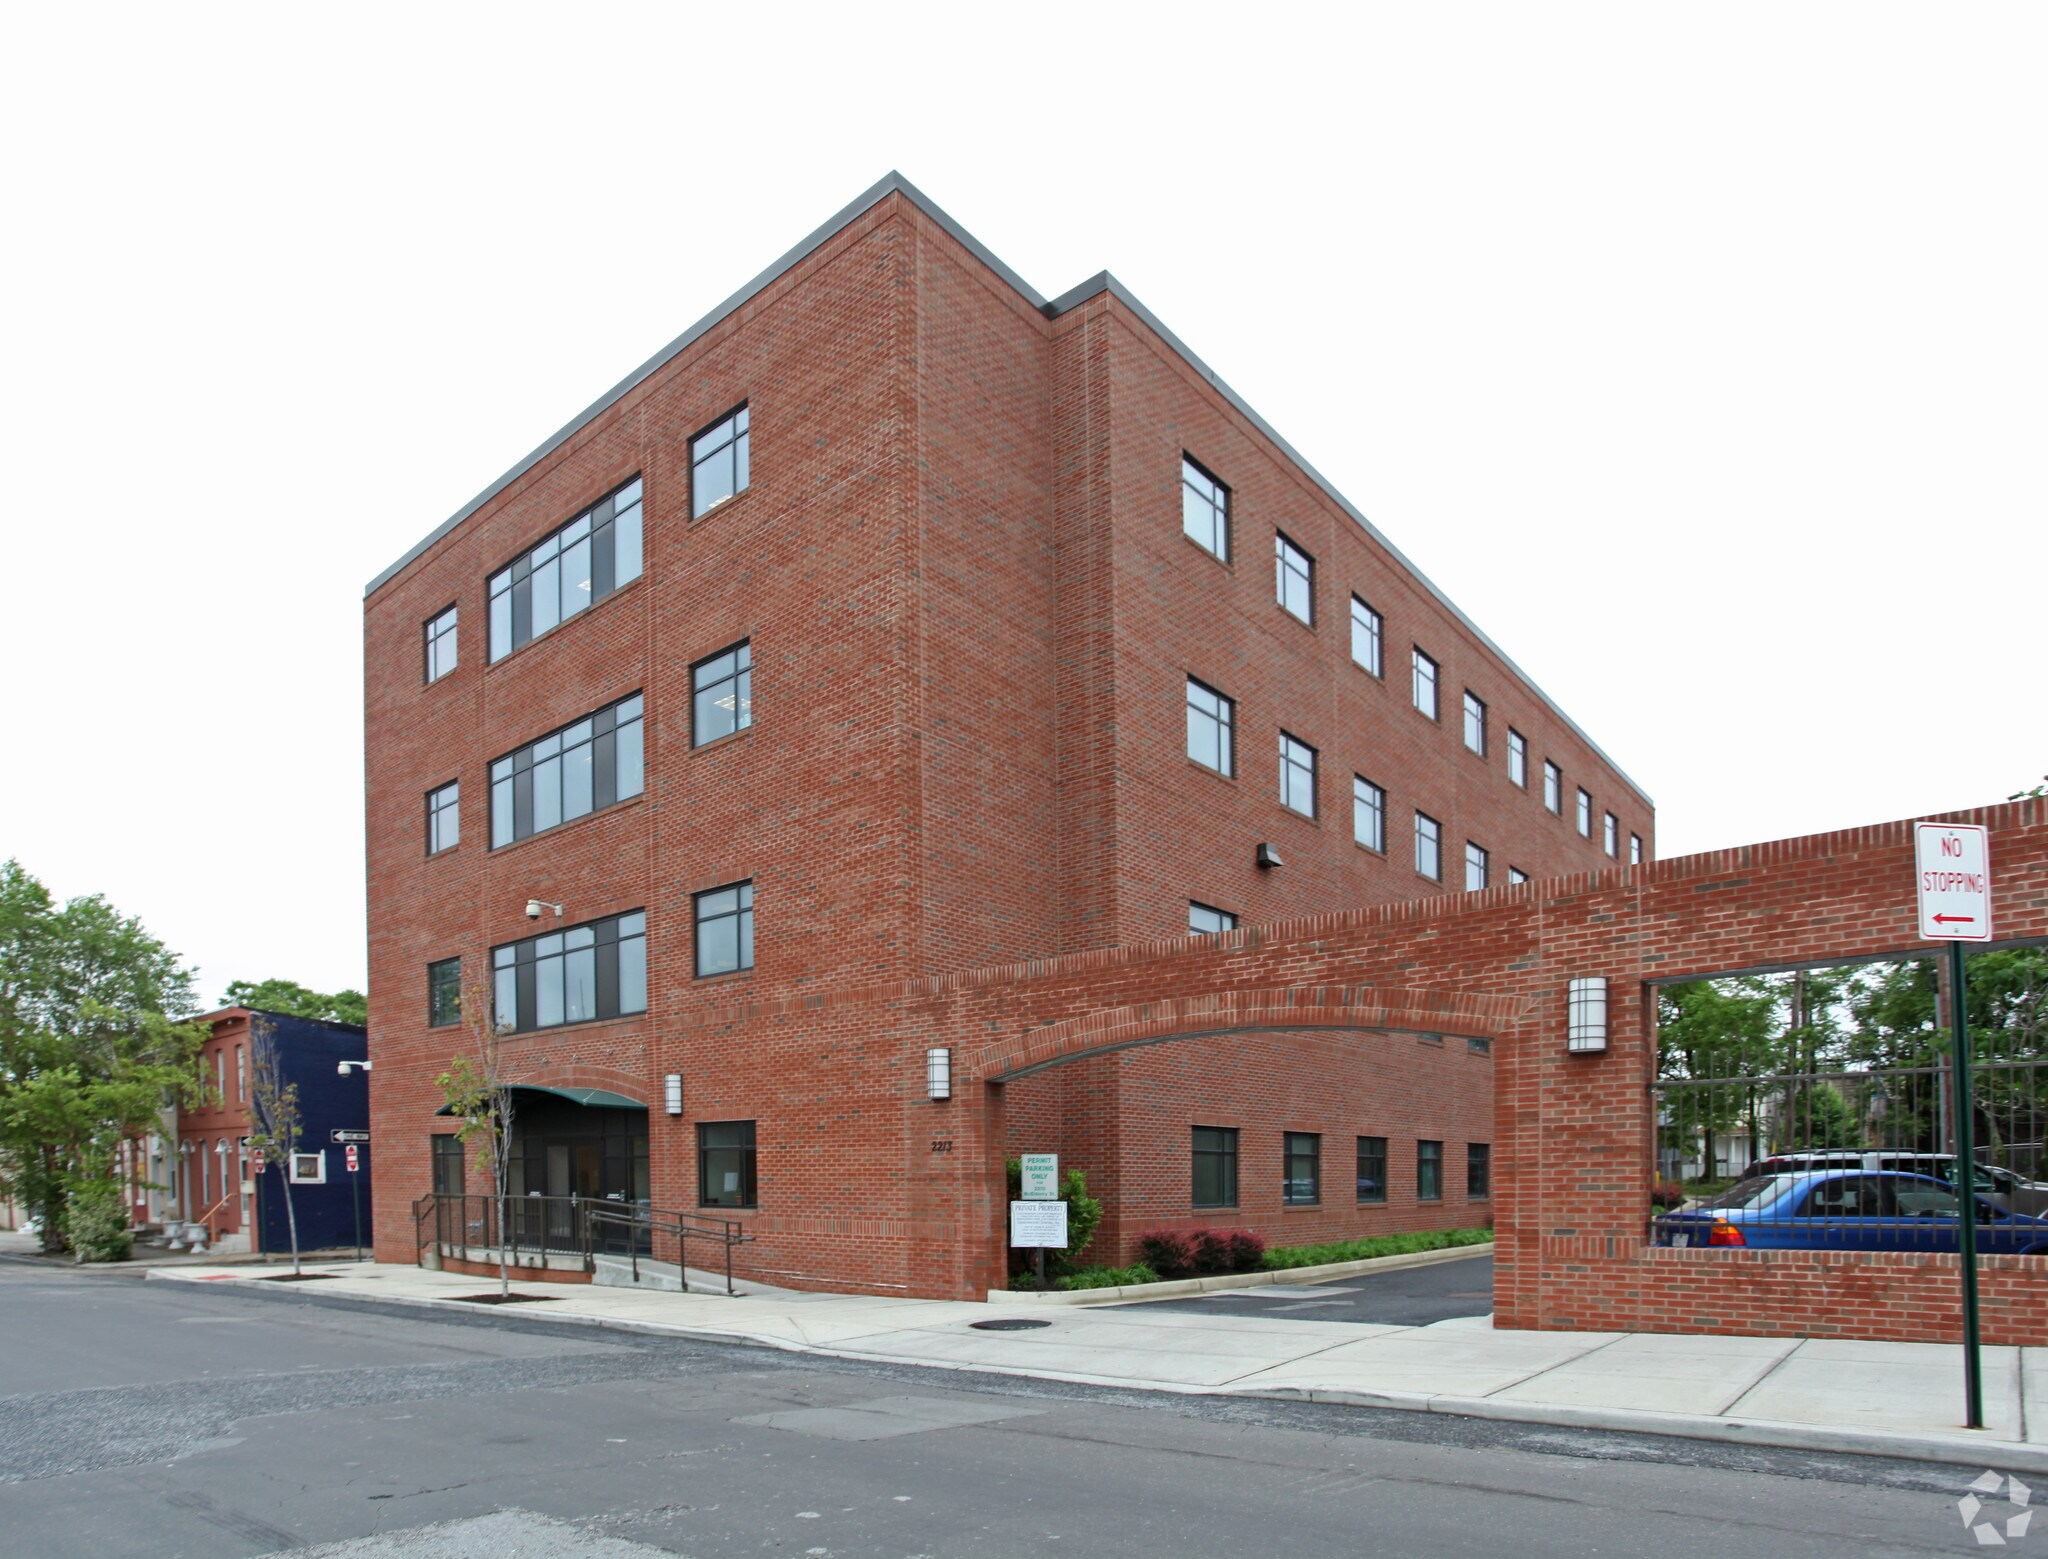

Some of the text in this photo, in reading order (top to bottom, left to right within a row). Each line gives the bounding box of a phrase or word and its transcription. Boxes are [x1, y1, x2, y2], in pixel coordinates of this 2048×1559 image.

[1941, 837, 1962, 857] NO
[1923, 871, 1984, 894] STOPPING
[932, 1141, 953, 1152] 2213
